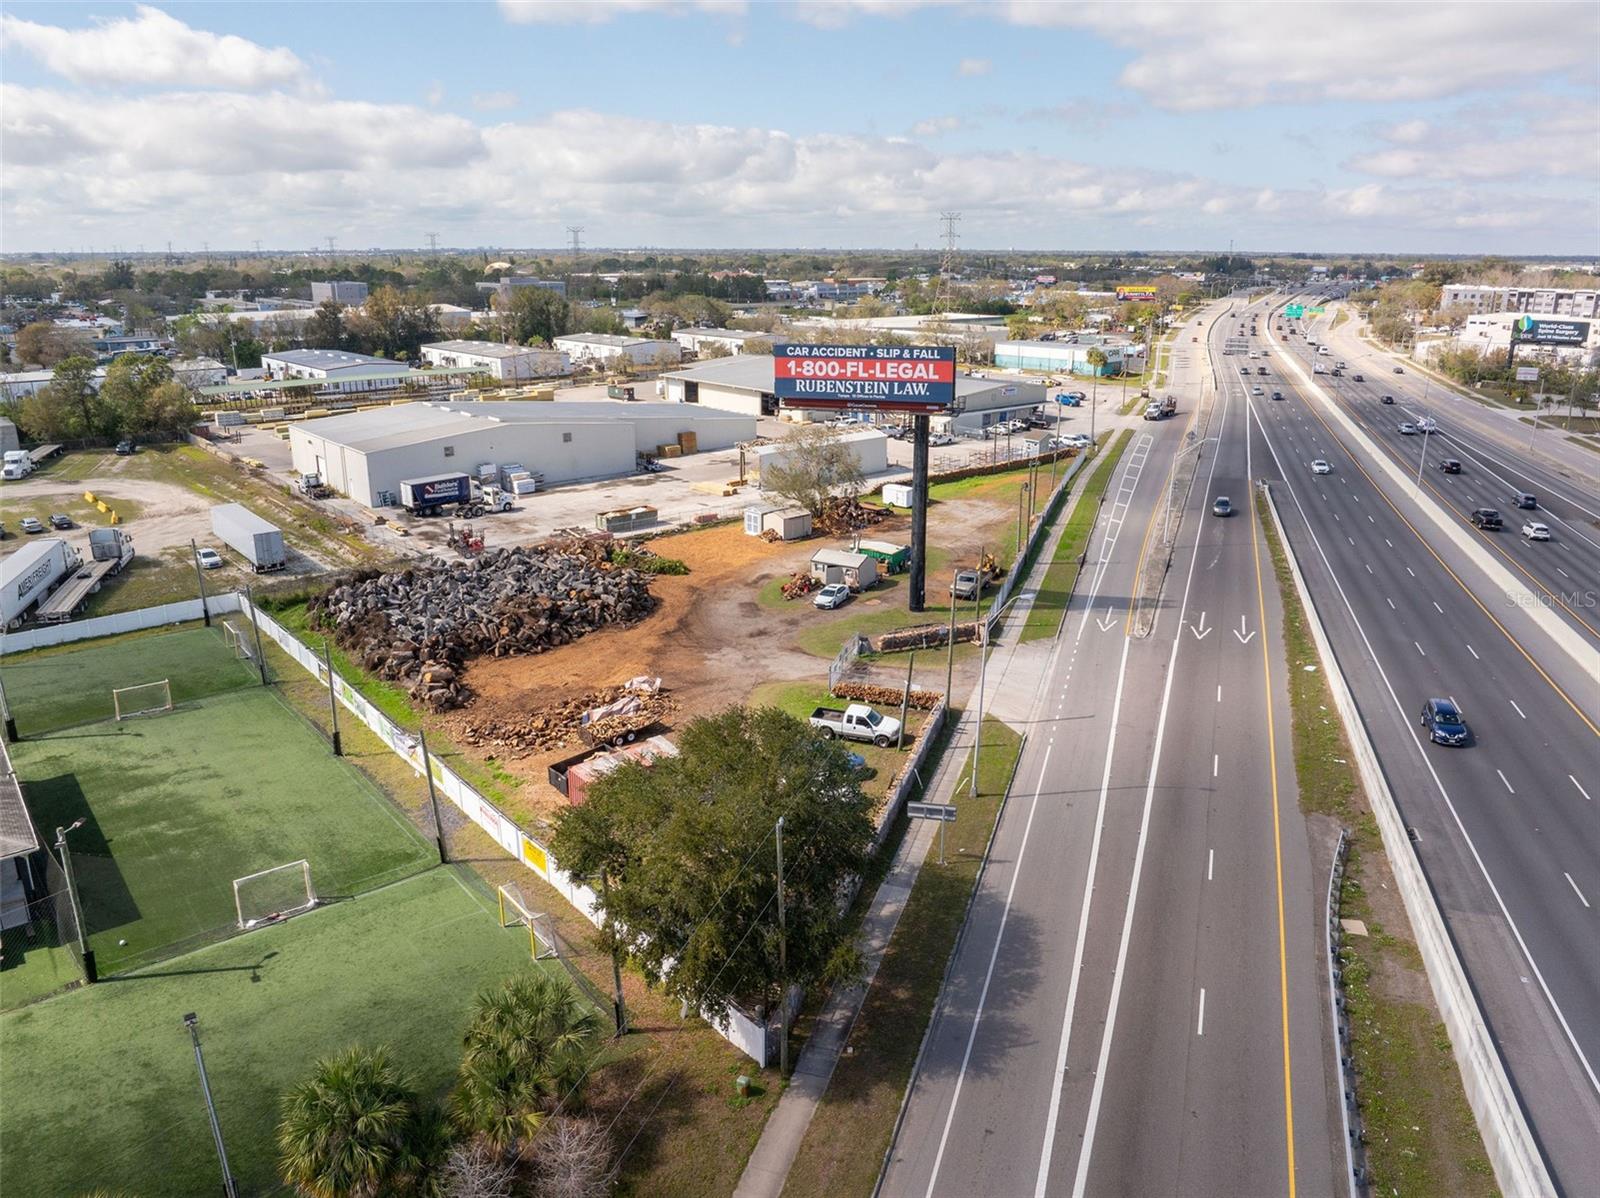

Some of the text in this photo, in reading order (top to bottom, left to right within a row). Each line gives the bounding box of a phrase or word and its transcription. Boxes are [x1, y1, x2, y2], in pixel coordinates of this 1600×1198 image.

[786, 347, 940, 359] CAR ACCIDENT SLIP & FALL
[787, 361, 939, 379] 1-800-FL-LEGAL
[795, 379, 930, 396] RUBENSTEIN LAW.
